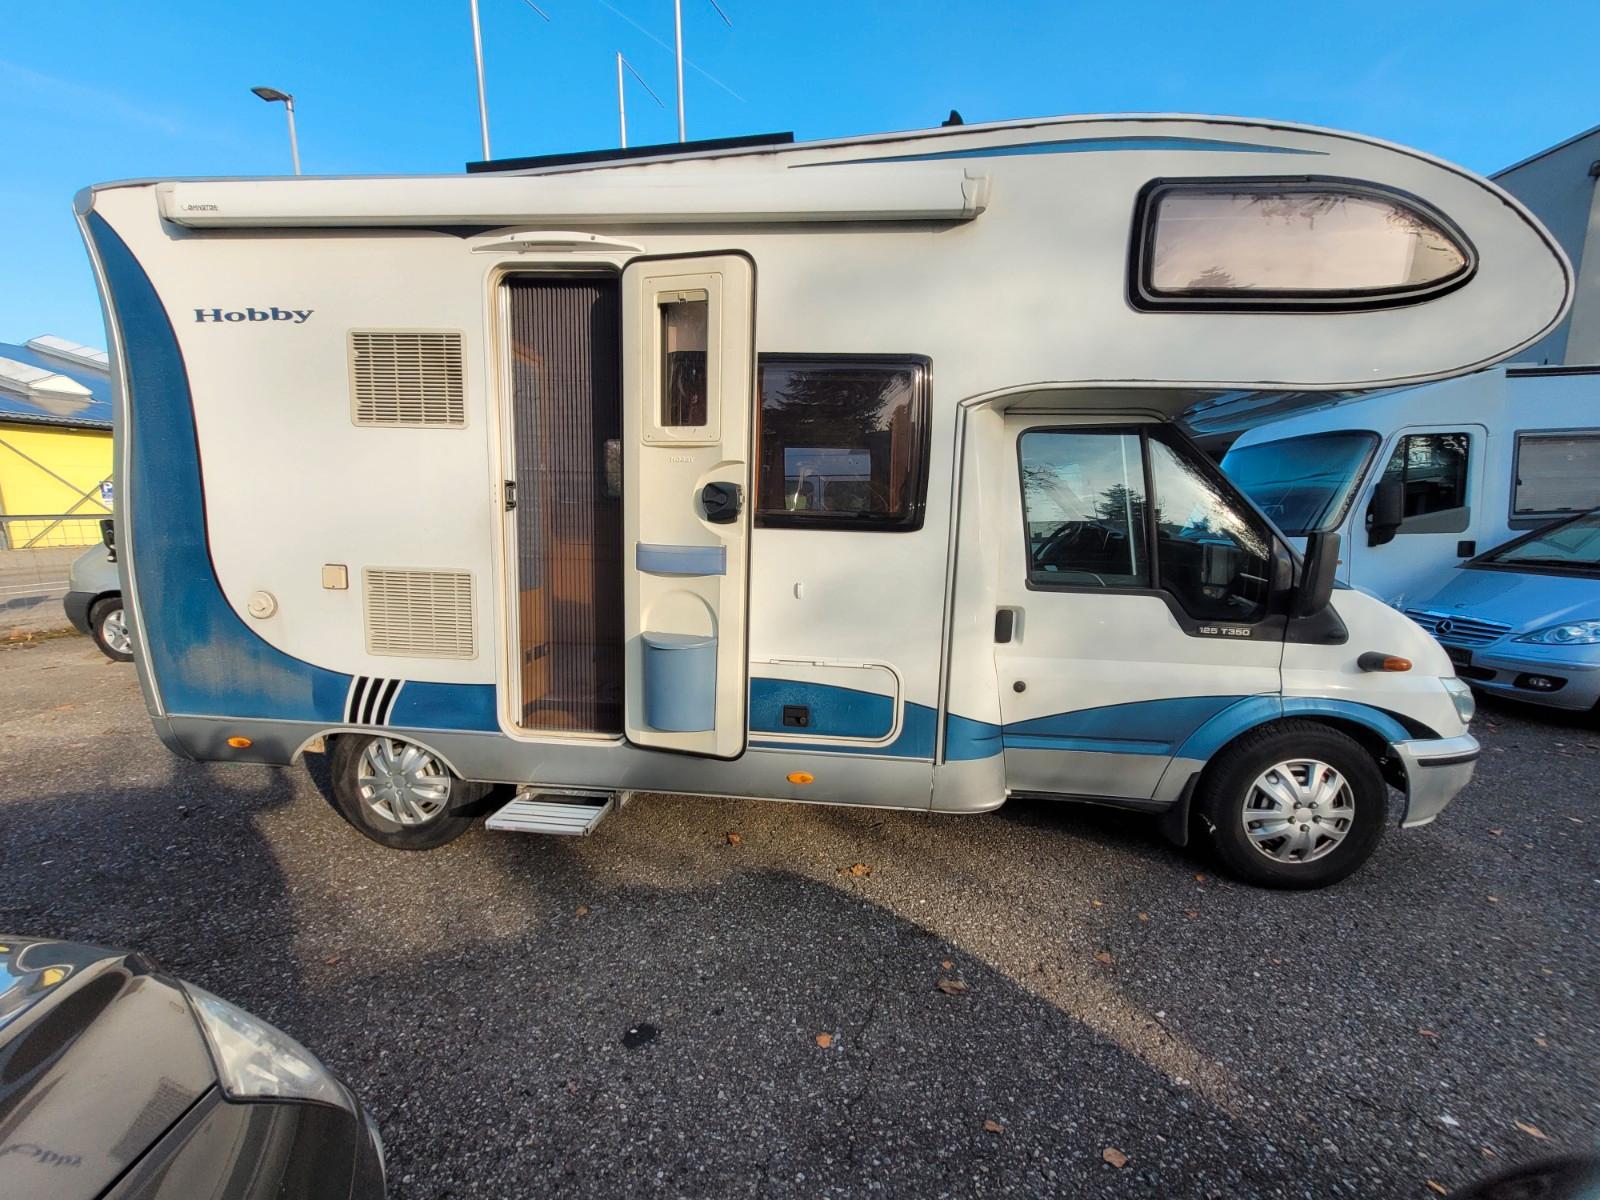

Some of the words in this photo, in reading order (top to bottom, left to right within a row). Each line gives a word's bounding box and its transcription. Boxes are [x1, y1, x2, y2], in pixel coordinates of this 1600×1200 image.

[194, 307, 315, 324] Hobby
[1199, 626, 1218, 635] 125
[1220, 627, 1251, 636] T350
